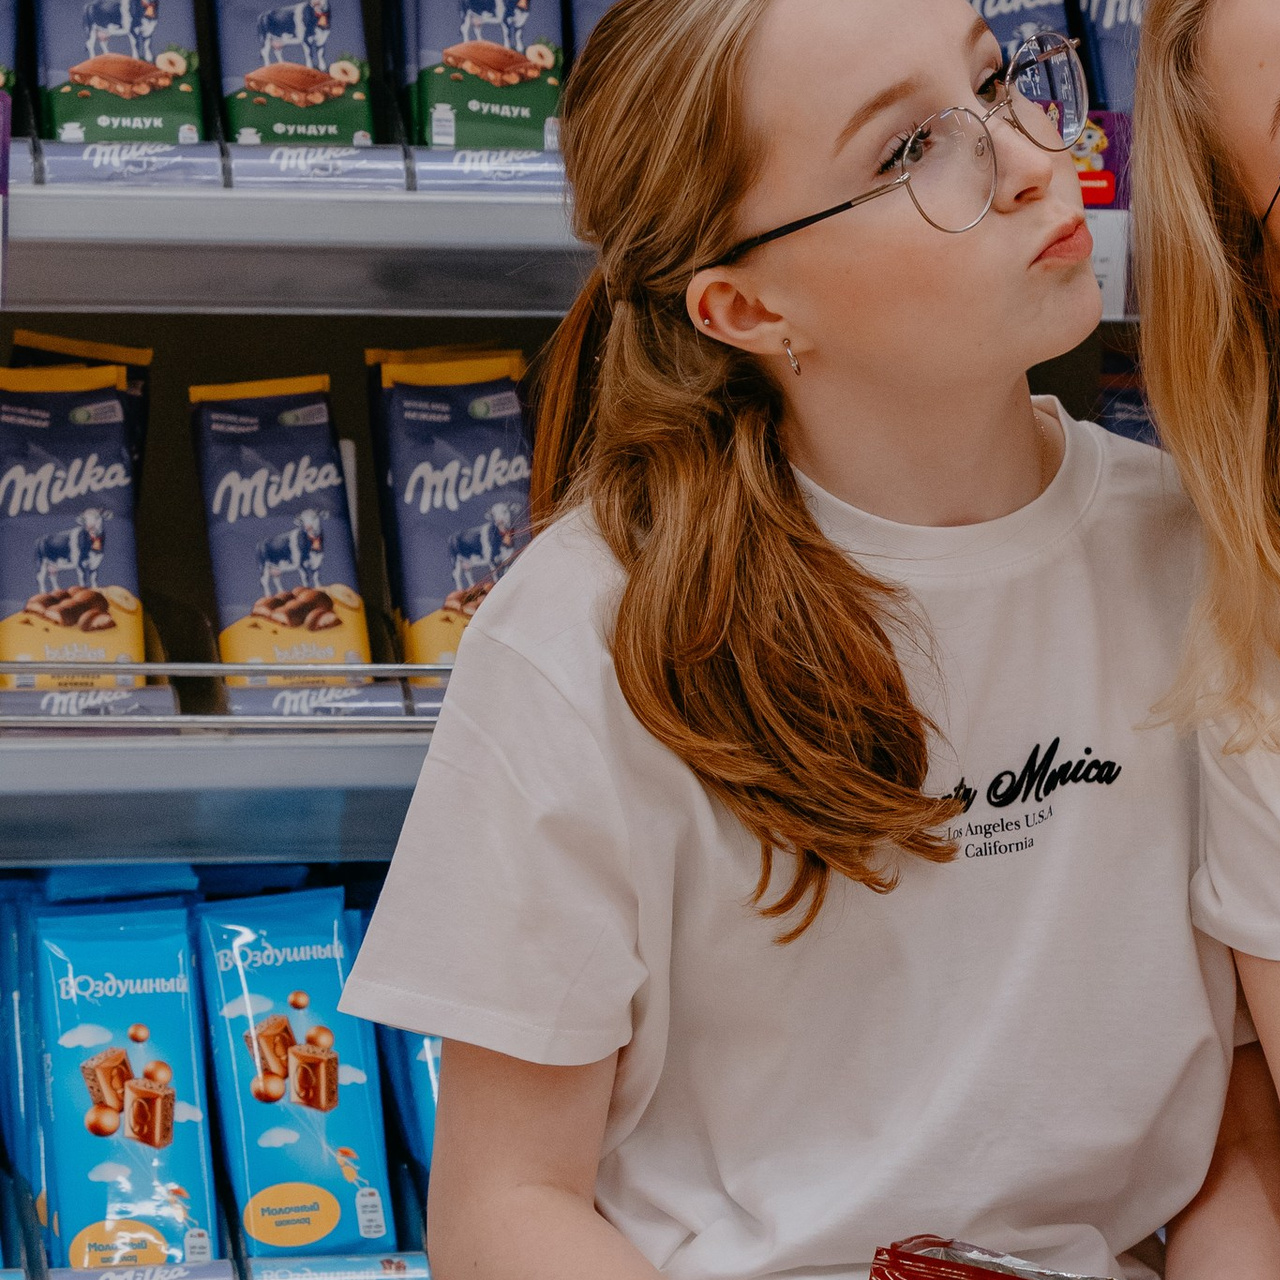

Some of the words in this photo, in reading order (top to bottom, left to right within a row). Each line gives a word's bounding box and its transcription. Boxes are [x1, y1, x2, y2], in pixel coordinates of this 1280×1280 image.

[467, 98, 531, 119] Фундук
[97, 113, 164, 130] Фундук
[272, 121, 339, 136] Фундук
[0, 454, 131, 517] Milka
[213, 455, 342, 523] Milka
[404, 448, 532, 515] Milka
[965, 818, 1021, 839] Angeles
[965, 837, 1034, 858] California
[261, 1202, 320, 1217] Молочный
